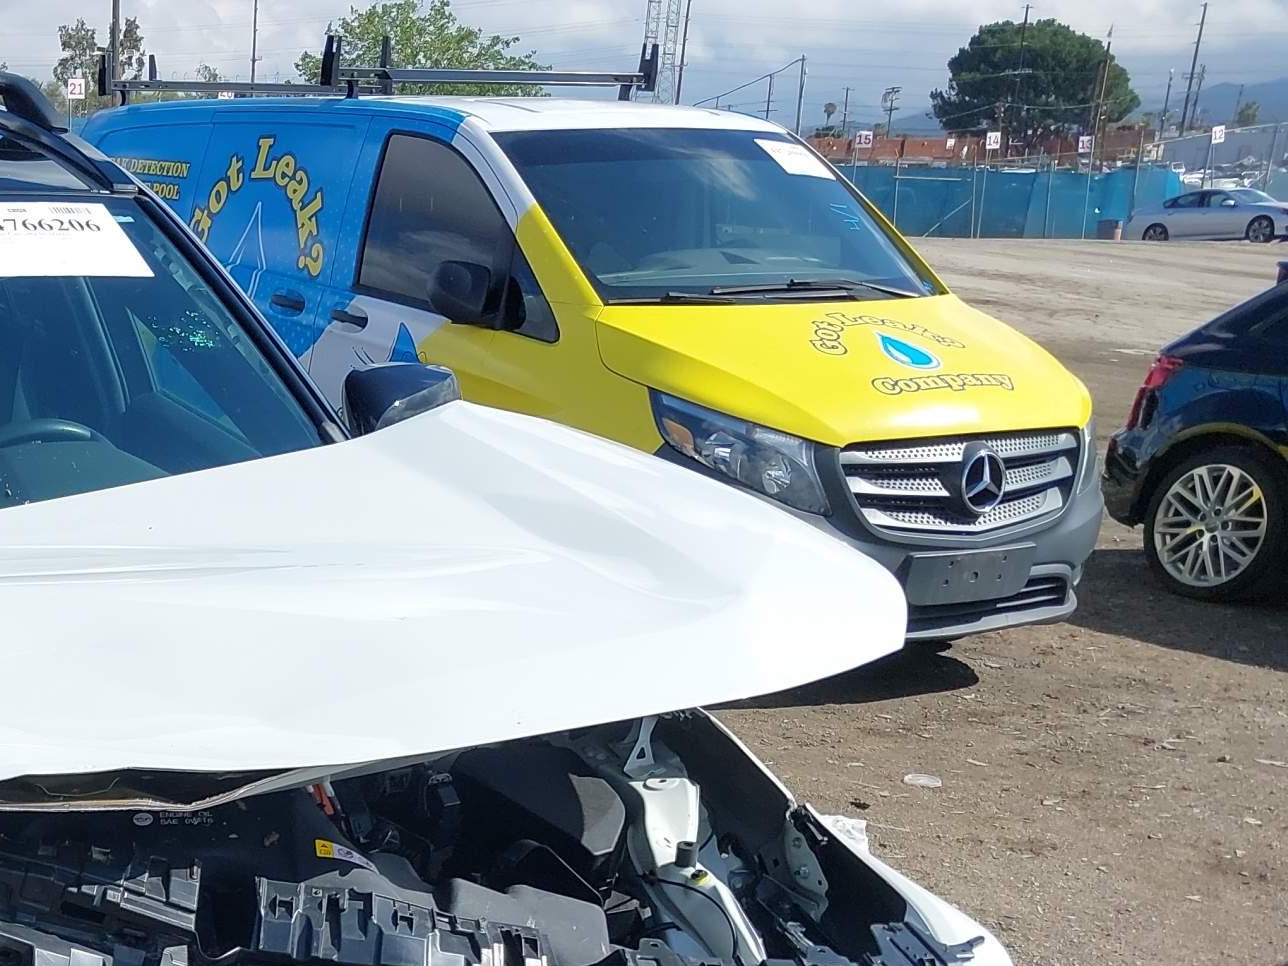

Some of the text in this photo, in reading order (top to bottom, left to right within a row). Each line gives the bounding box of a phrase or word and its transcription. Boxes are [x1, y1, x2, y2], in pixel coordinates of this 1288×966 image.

[69, 83, 83, 95] 21
[857, 133, 872, 145] 15
[987, 135, 1000, 146] 14
[1214, 129, 1224, 140] 12
[129, 159, 191, 178] DETECTION
[152, 183, 180, 200] POOL
[250, 137, 324, 277] Leak?
[809, 319, 848, 356] Got
[872, 373, 1015, 396] Company
